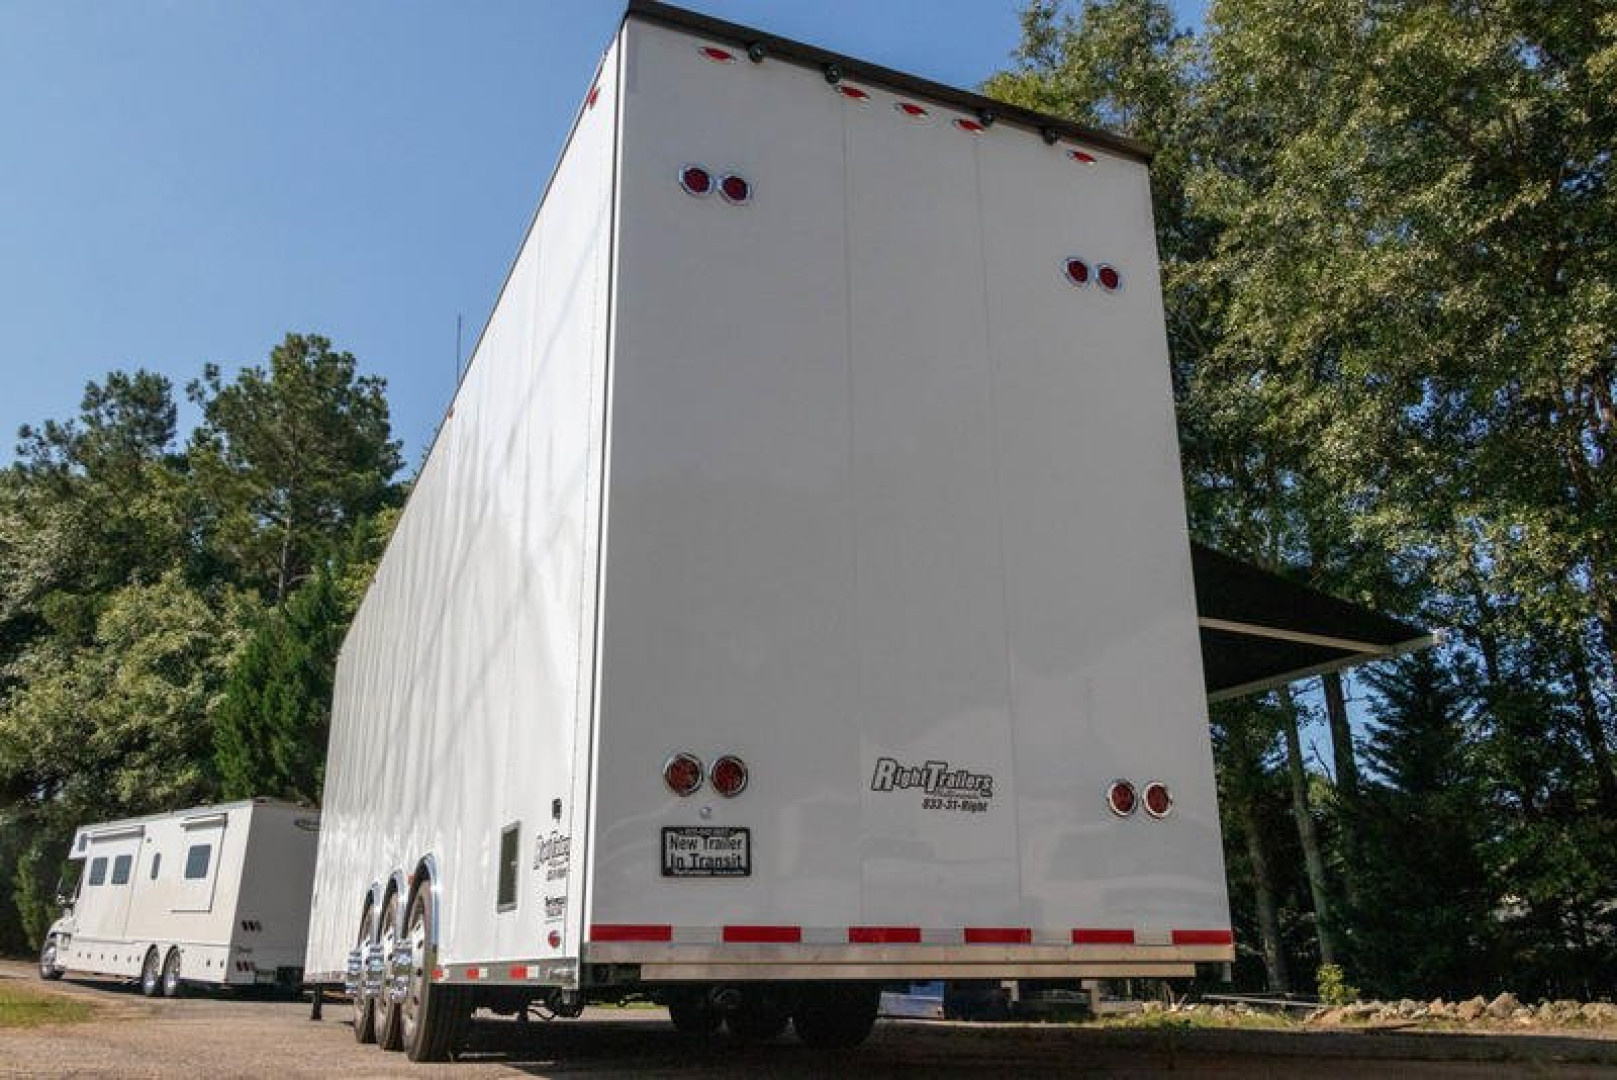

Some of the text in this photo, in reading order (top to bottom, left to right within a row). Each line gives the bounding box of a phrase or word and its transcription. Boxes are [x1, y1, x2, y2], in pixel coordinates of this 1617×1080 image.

[669, 834, 743, 850] New Trailer
[669, 852, 742, 869] In Transit
